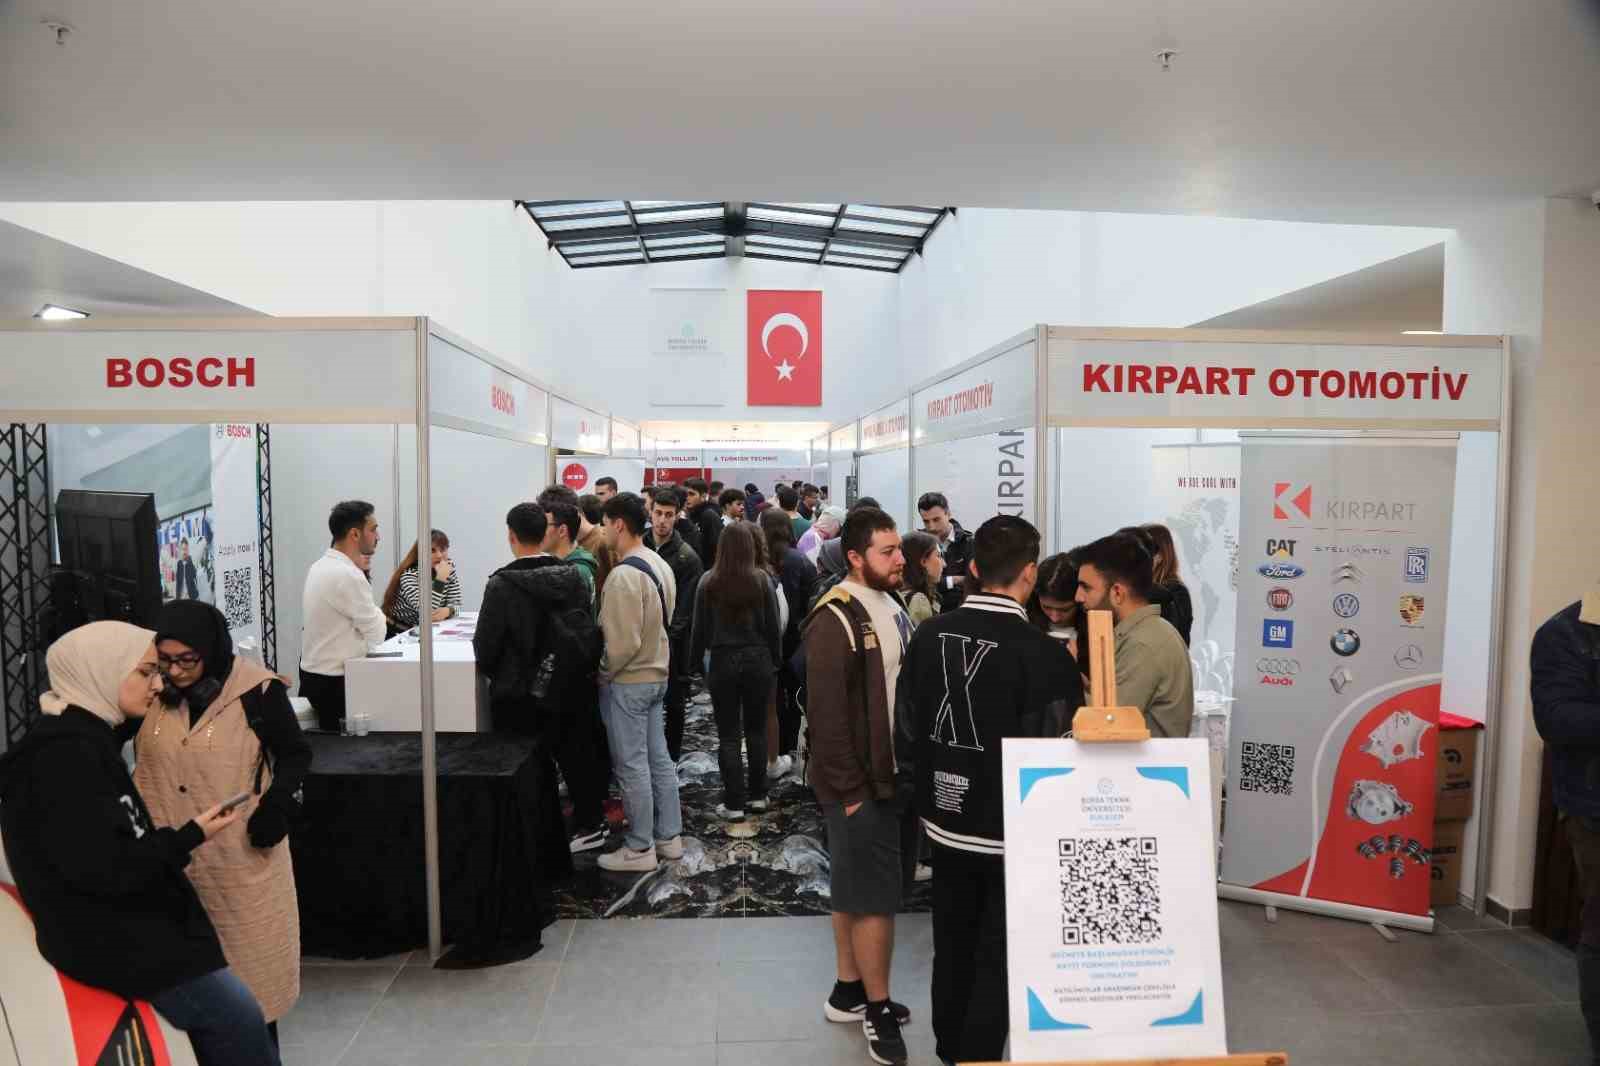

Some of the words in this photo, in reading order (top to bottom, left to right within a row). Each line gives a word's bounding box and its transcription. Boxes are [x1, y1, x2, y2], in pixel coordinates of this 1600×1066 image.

[106, 357, 255, 388] BOSCH
[1083, 364, 1256, 395] KIRPART
[1268, 366, 1469, 400] OTOMOTİV
[491, 385, 516, 416] BOSCH
[928, 394, 952, 417] KIRPART
[226, 425, 251, 438] BOSCH
[1177, 477, 1187, 489] WE
[1220, 477, 1237, 489] WITH
[1327, 500, 1416, 521] KIRPART
[1266, 538, 1297, 557] CAT
[1266, 565, 1298, 577] Ford
[1270, 625, 1287, 638] GM
[1261, 674, 1294, 686] Audi
